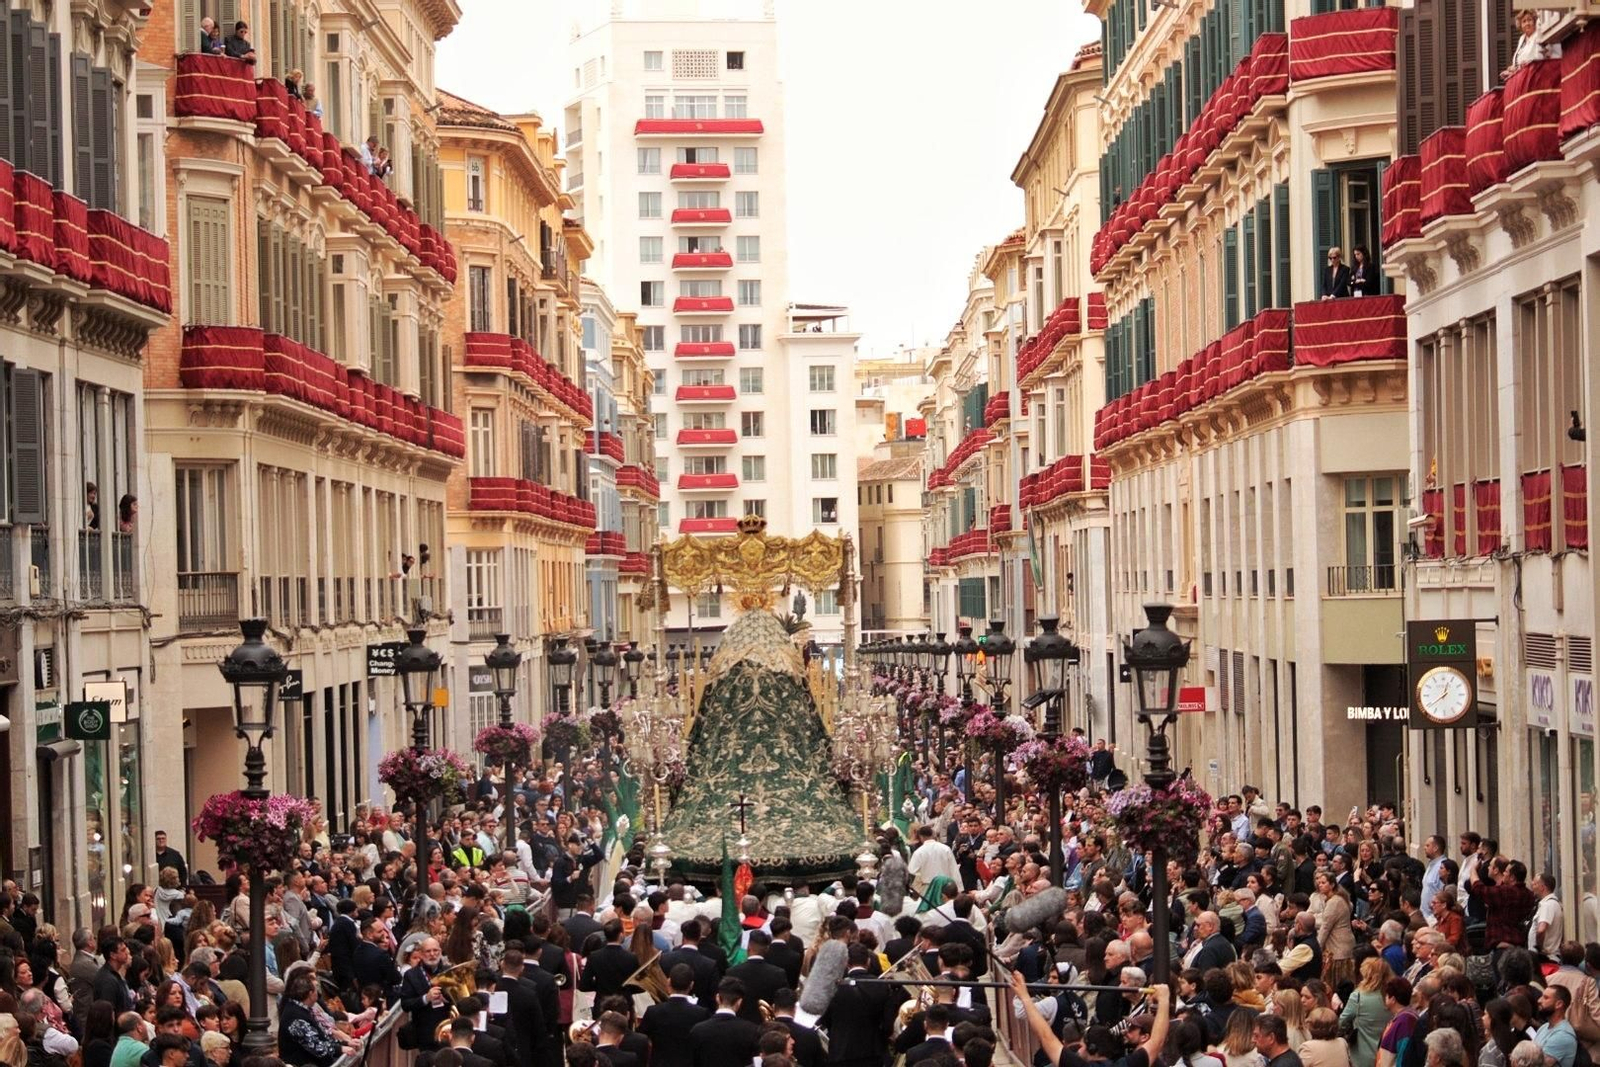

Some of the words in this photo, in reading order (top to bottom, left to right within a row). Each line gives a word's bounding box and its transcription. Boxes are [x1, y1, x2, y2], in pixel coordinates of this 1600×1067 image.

[1418, 644, 1467, 655] ROLEX
[369, 660, 395, 668] Chang
[1532, 674, 1554, 711] KIKO
[1575, 679, 1593, 717] KIK
[1347, 707, 1382, 719] BIMBA
[1384, 707, 1391, 719] Y
